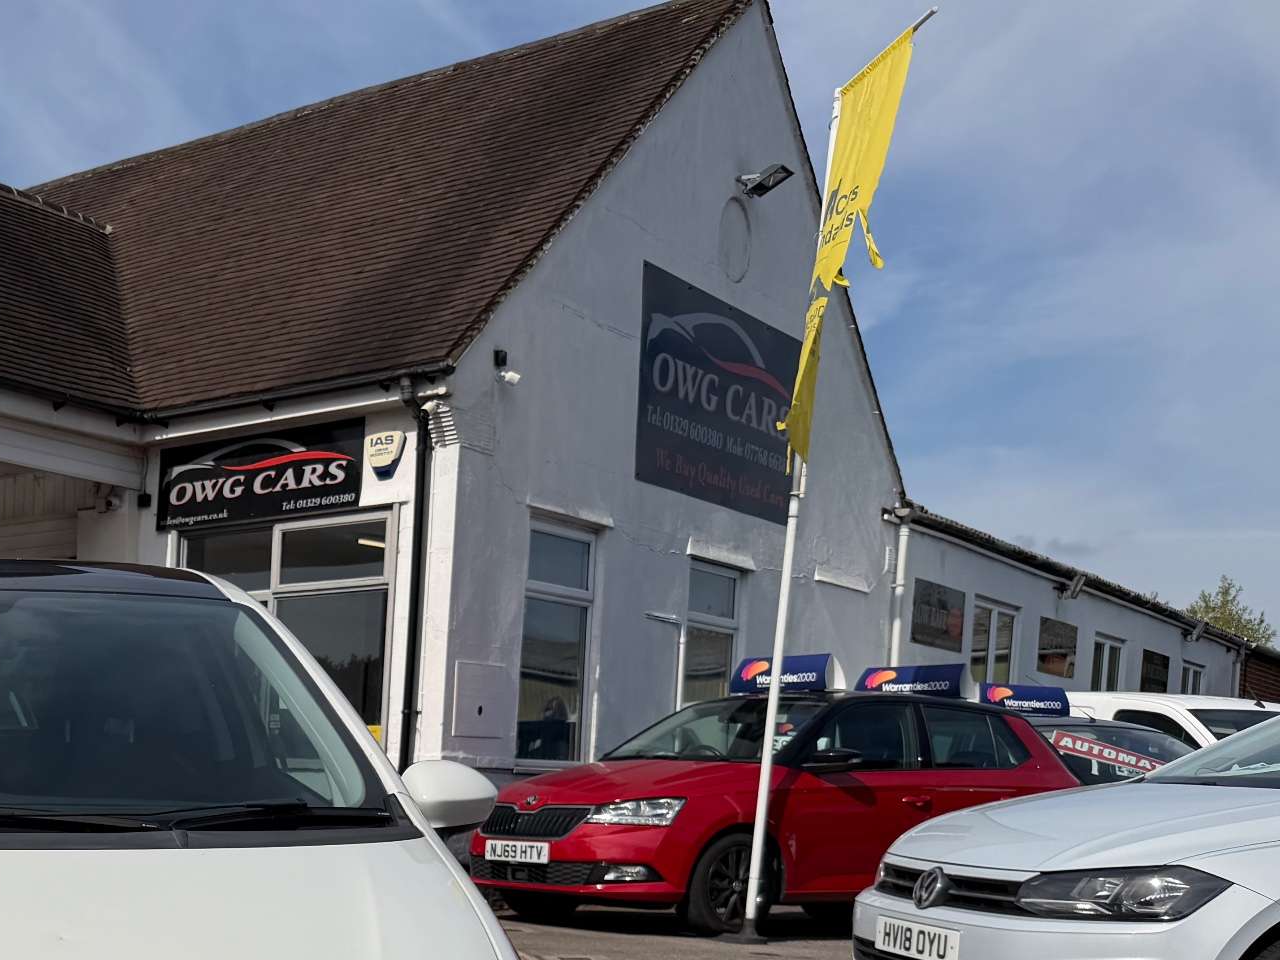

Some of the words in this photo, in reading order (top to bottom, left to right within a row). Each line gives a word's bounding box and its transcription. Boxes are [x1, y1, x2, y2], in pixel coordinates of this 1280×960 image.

[653, 353, 719, 412] OWG
[370, 435, 394, 448] IAS
[170, 475, 245, 506] OWG
[253, 460, 349, 496] CARS
[282, 501, 295, 511] Tel:
[321, 492, 356, 507] 600380
[489, 843, 517, 858] NJ69
[520, 845, 543, 860] HTV
[882, 922, 913, 952] HV18
[916, 930, 948, 960] OYU
